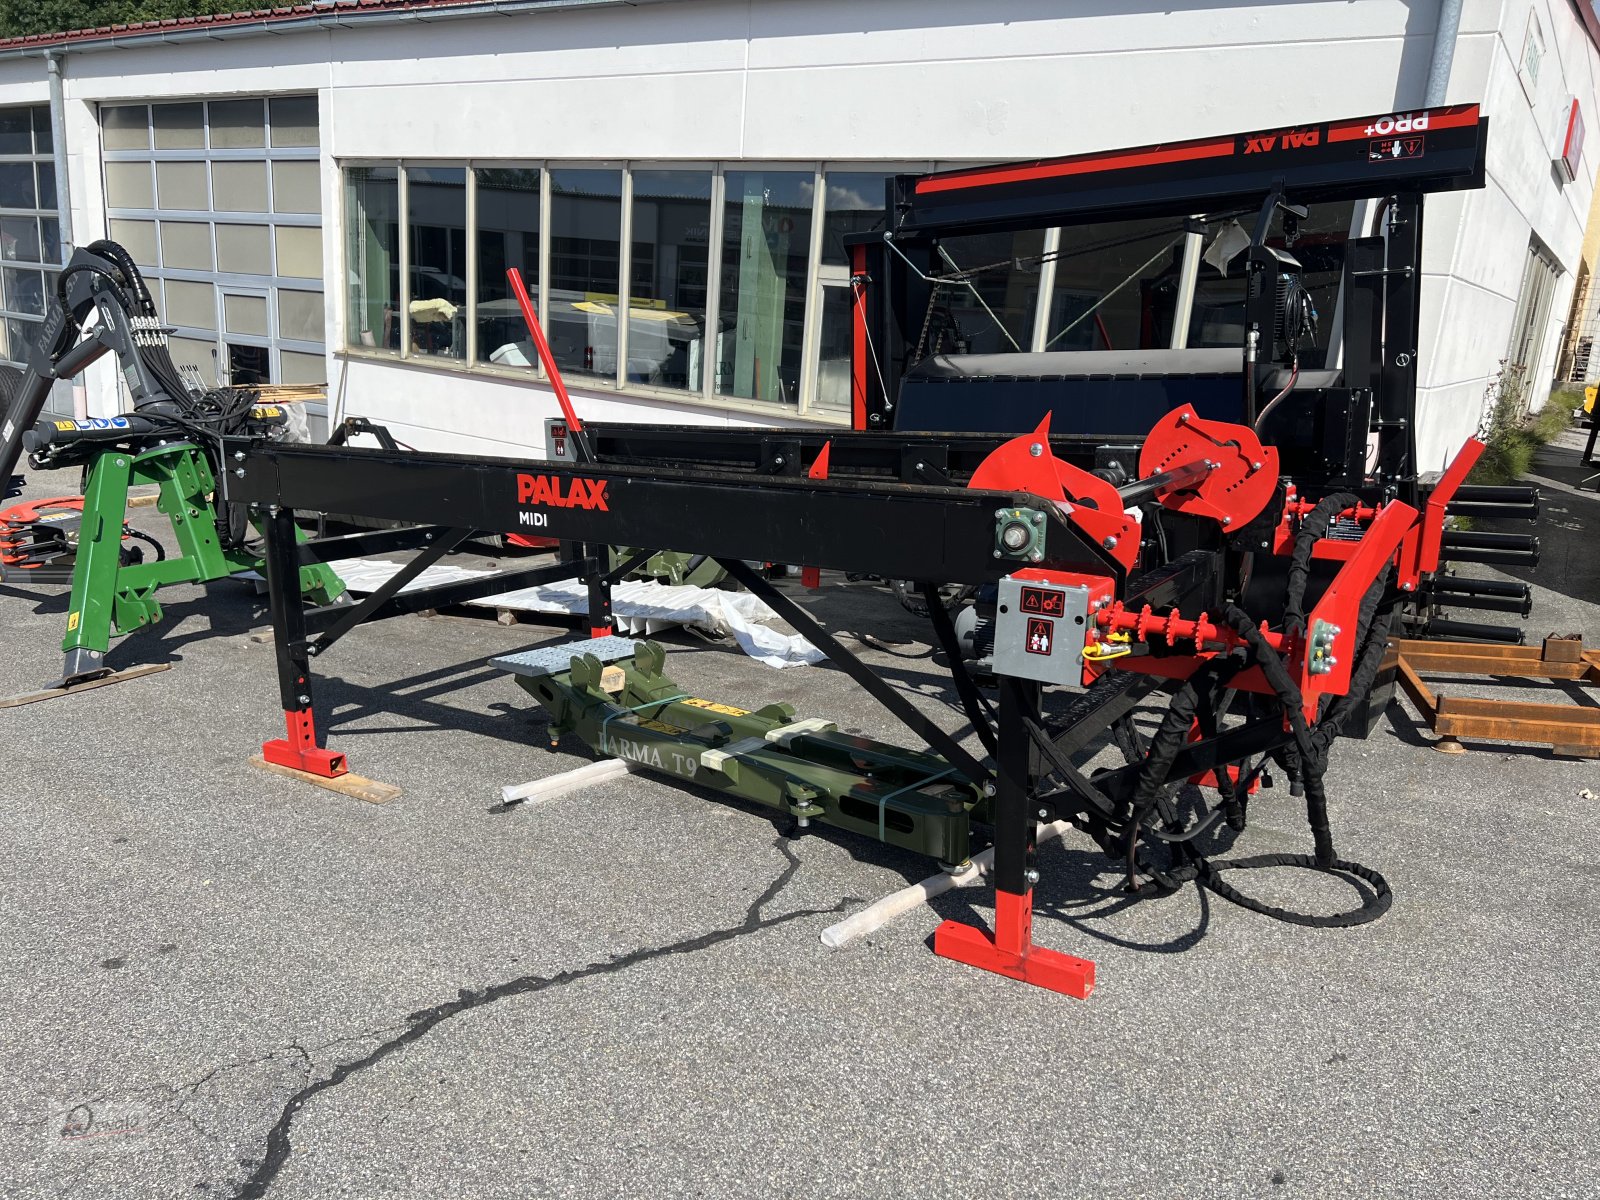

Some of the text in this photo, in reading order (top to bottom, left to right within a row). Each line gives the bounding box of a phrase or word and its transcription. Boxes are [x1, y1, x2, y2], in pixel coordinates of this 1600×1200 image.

[1363, 110, 1429, 136] PRO+
[38, 304, 63, 354] FARMA
[516, 473, 609, 511] PALAX
[519, 511, 548, 527] MIDI
[672, 752, 697, 777] T9
